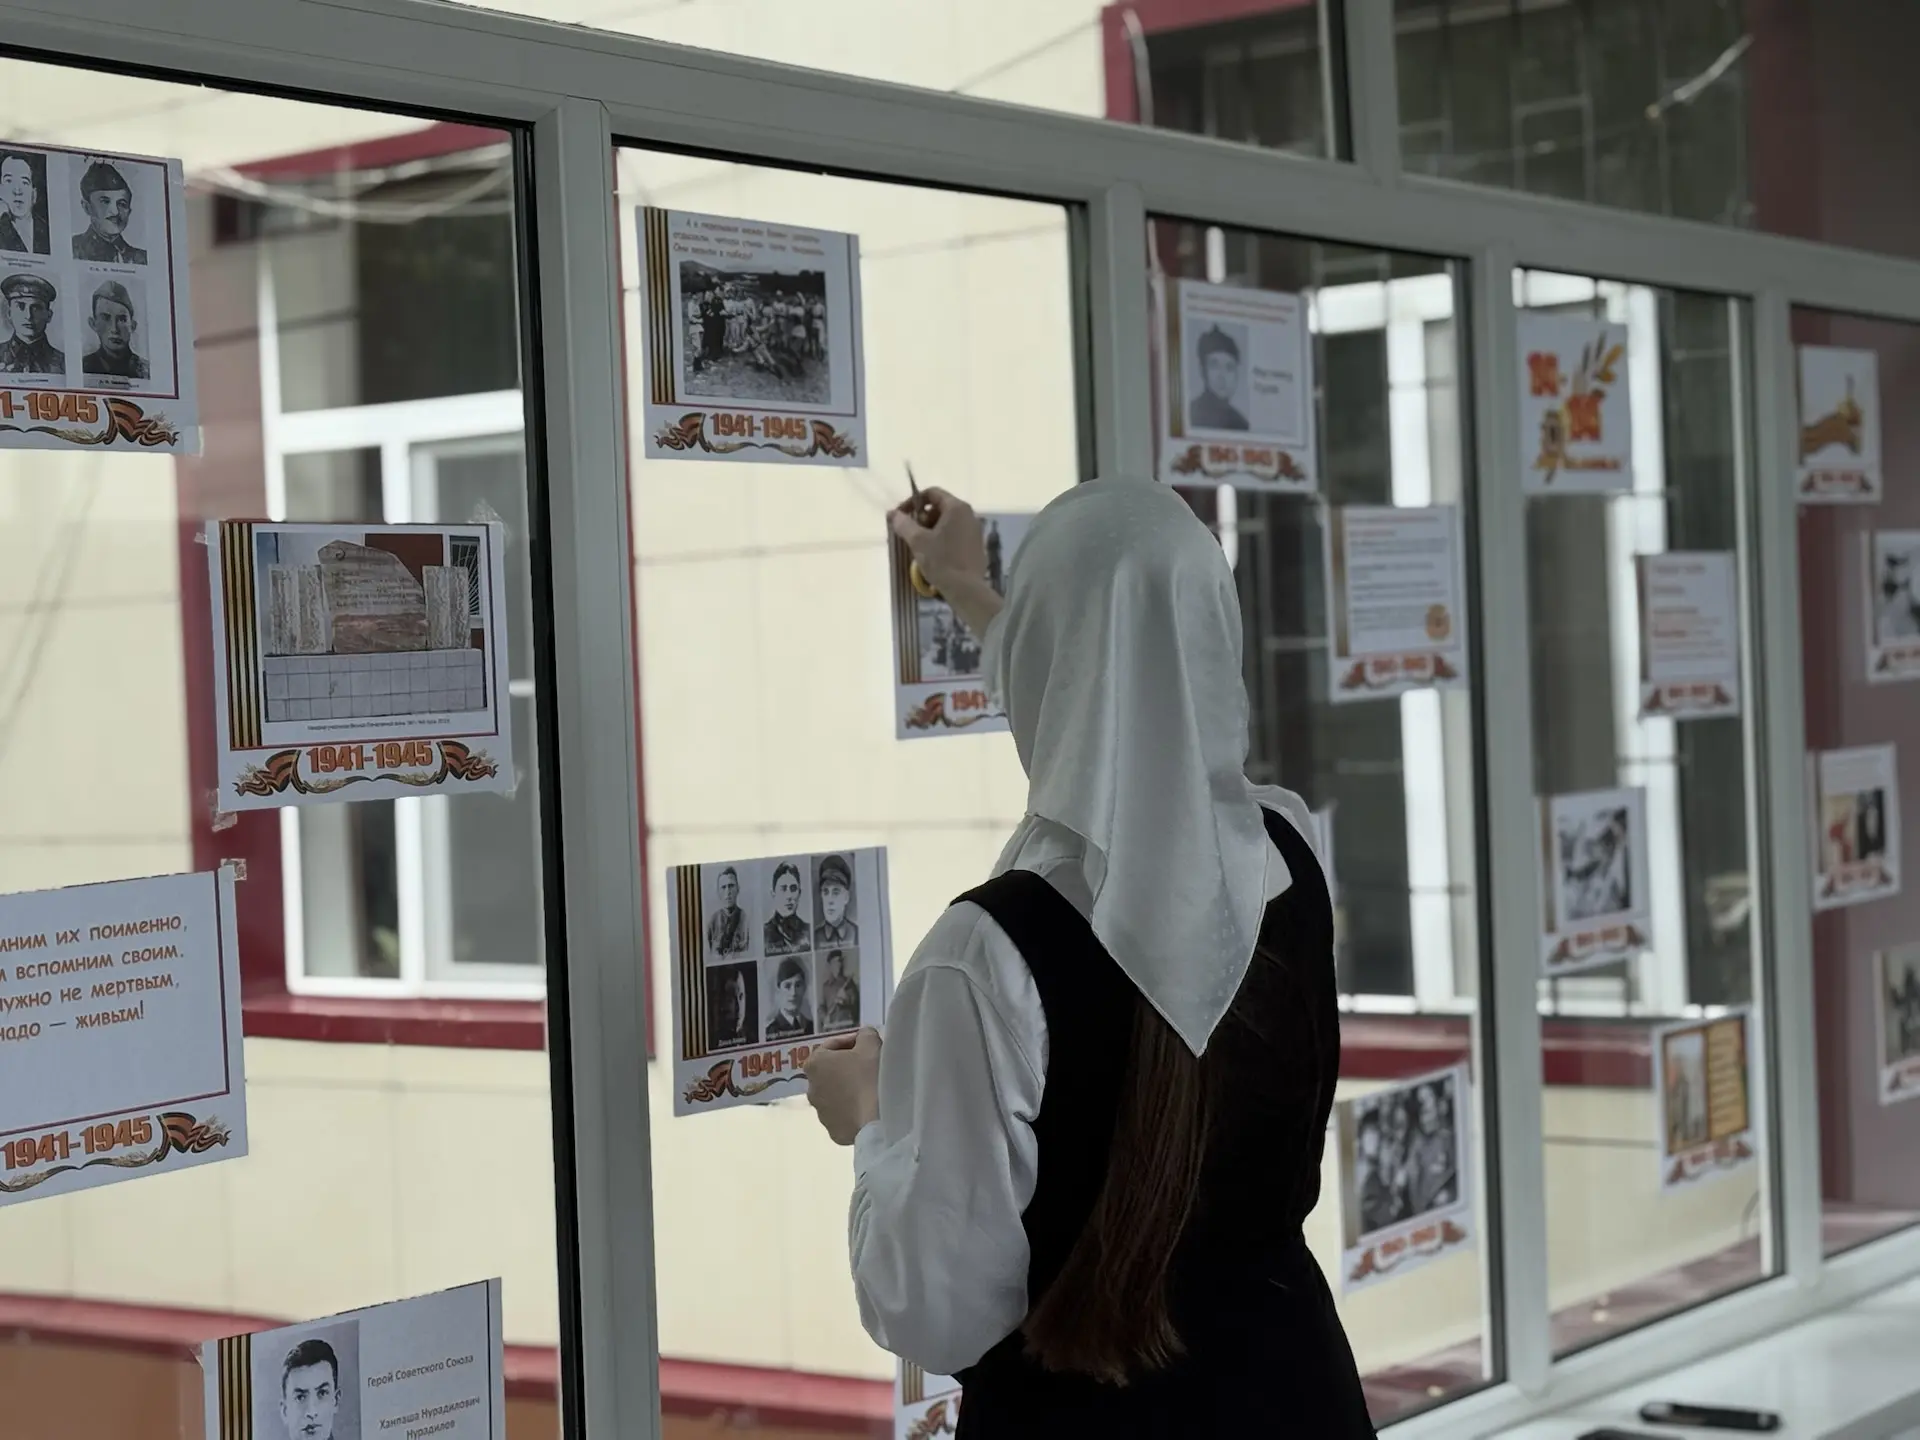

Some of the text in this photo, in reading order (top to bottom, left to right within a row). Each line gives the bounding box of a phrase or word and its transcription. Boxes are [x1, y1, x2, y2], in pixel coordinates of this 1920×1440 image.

[709, 412, 808, 440] 1941-1945
[306, 741, 434, 773] 1941-1945
[56, 928, 81, 945] их
[89, 915, 188, 942] поименно,
[15, 954, 114, 980] вспомним
[121, 944, 184, 965] своим.
[60, 987, 82, 1002] не
[91, 973, 180, 999] мертвым,
[75, 999, 145, 1029] живым!
[737, 1044, 821, 1079] 1941-19
[0, 1115, 153, 1169] 1941-1945
[367, 1354, 474, 1388] Герой Советского Союза
[379, 1396, 480, 1430] Ханпаша Нурадилович
